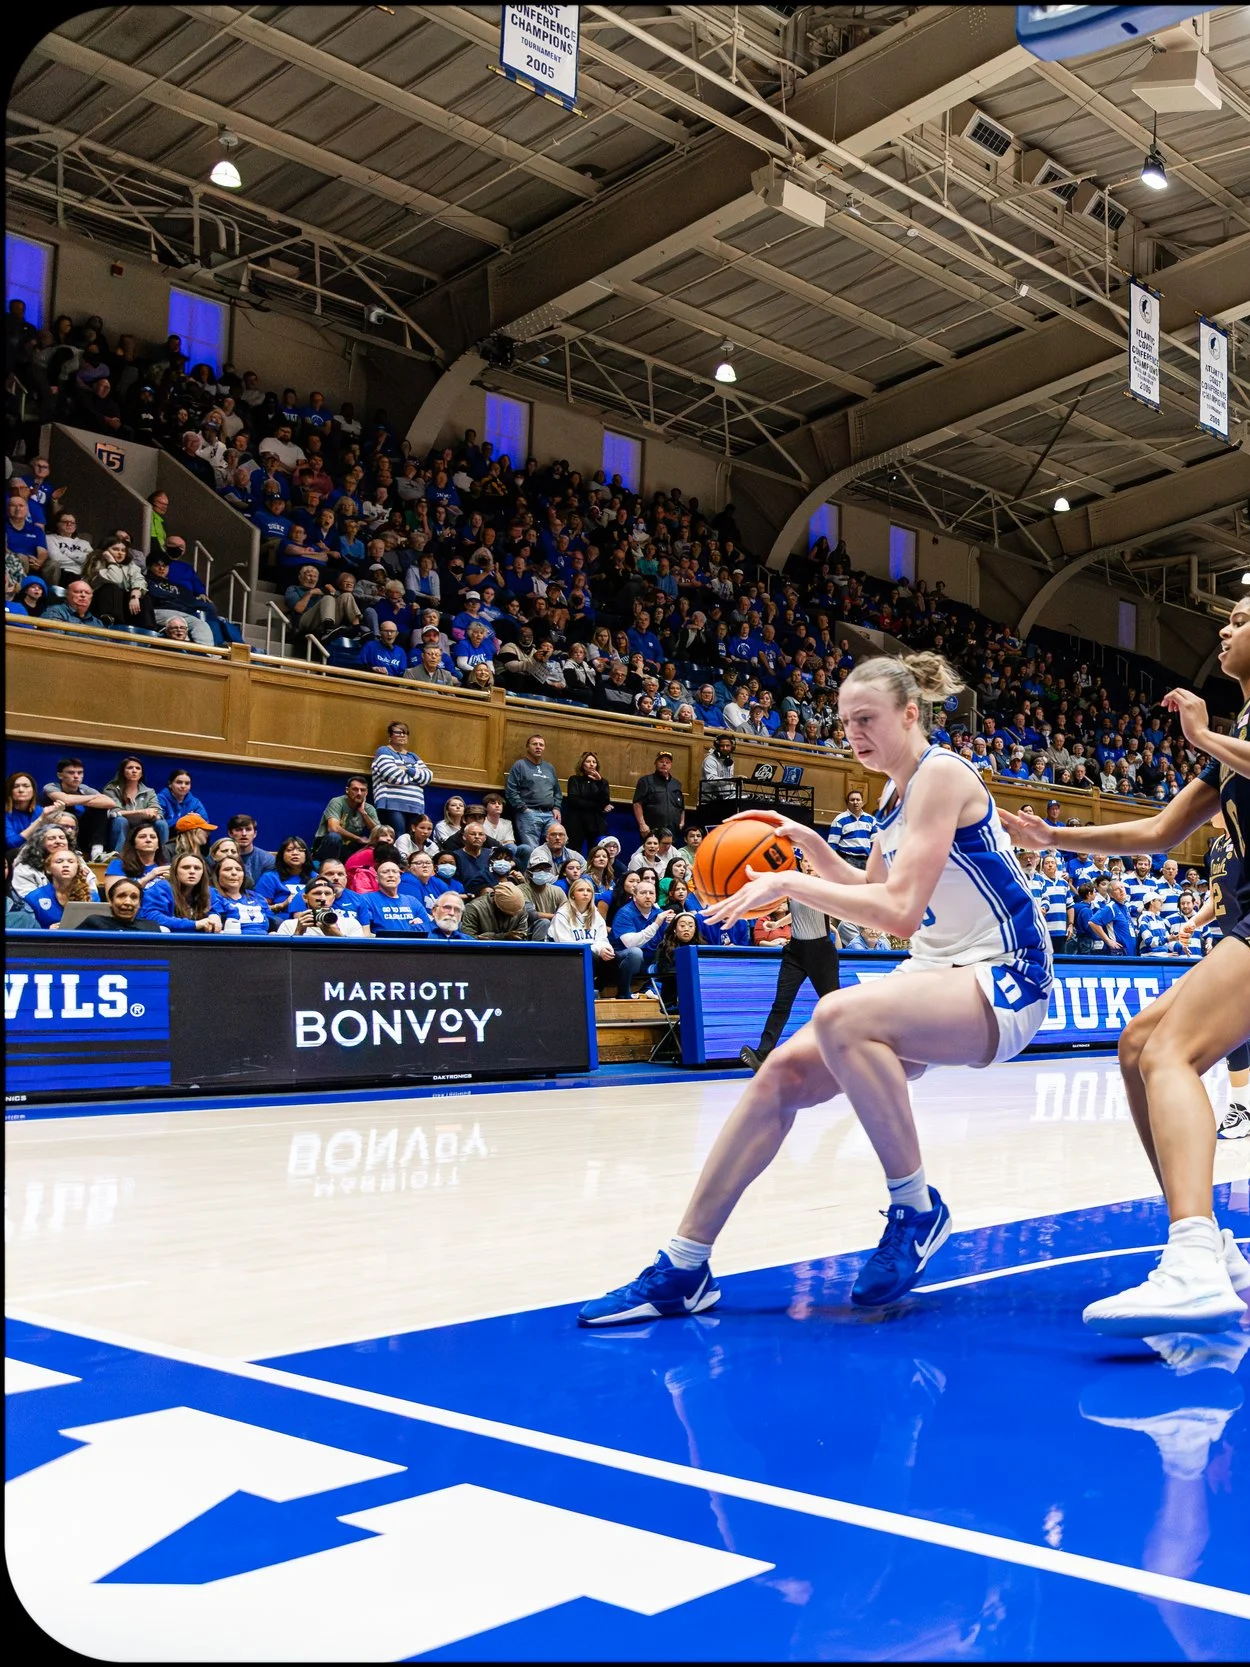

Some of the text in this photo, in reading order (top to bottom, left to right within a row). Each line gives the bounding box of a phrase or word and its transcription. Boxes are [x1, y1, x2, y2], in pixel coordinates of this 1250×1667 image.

[511, 13, 573, 55] CHAMPIONS
[521, 36, 562, 63] TOURNAMENT
[526, 55, 555, 79] 2005
[101, 451, 121, 470] 15
[324, 981, 469, 1001] MARRIOTT
[433, 1073, 472, 1081] DAKTRONICS
